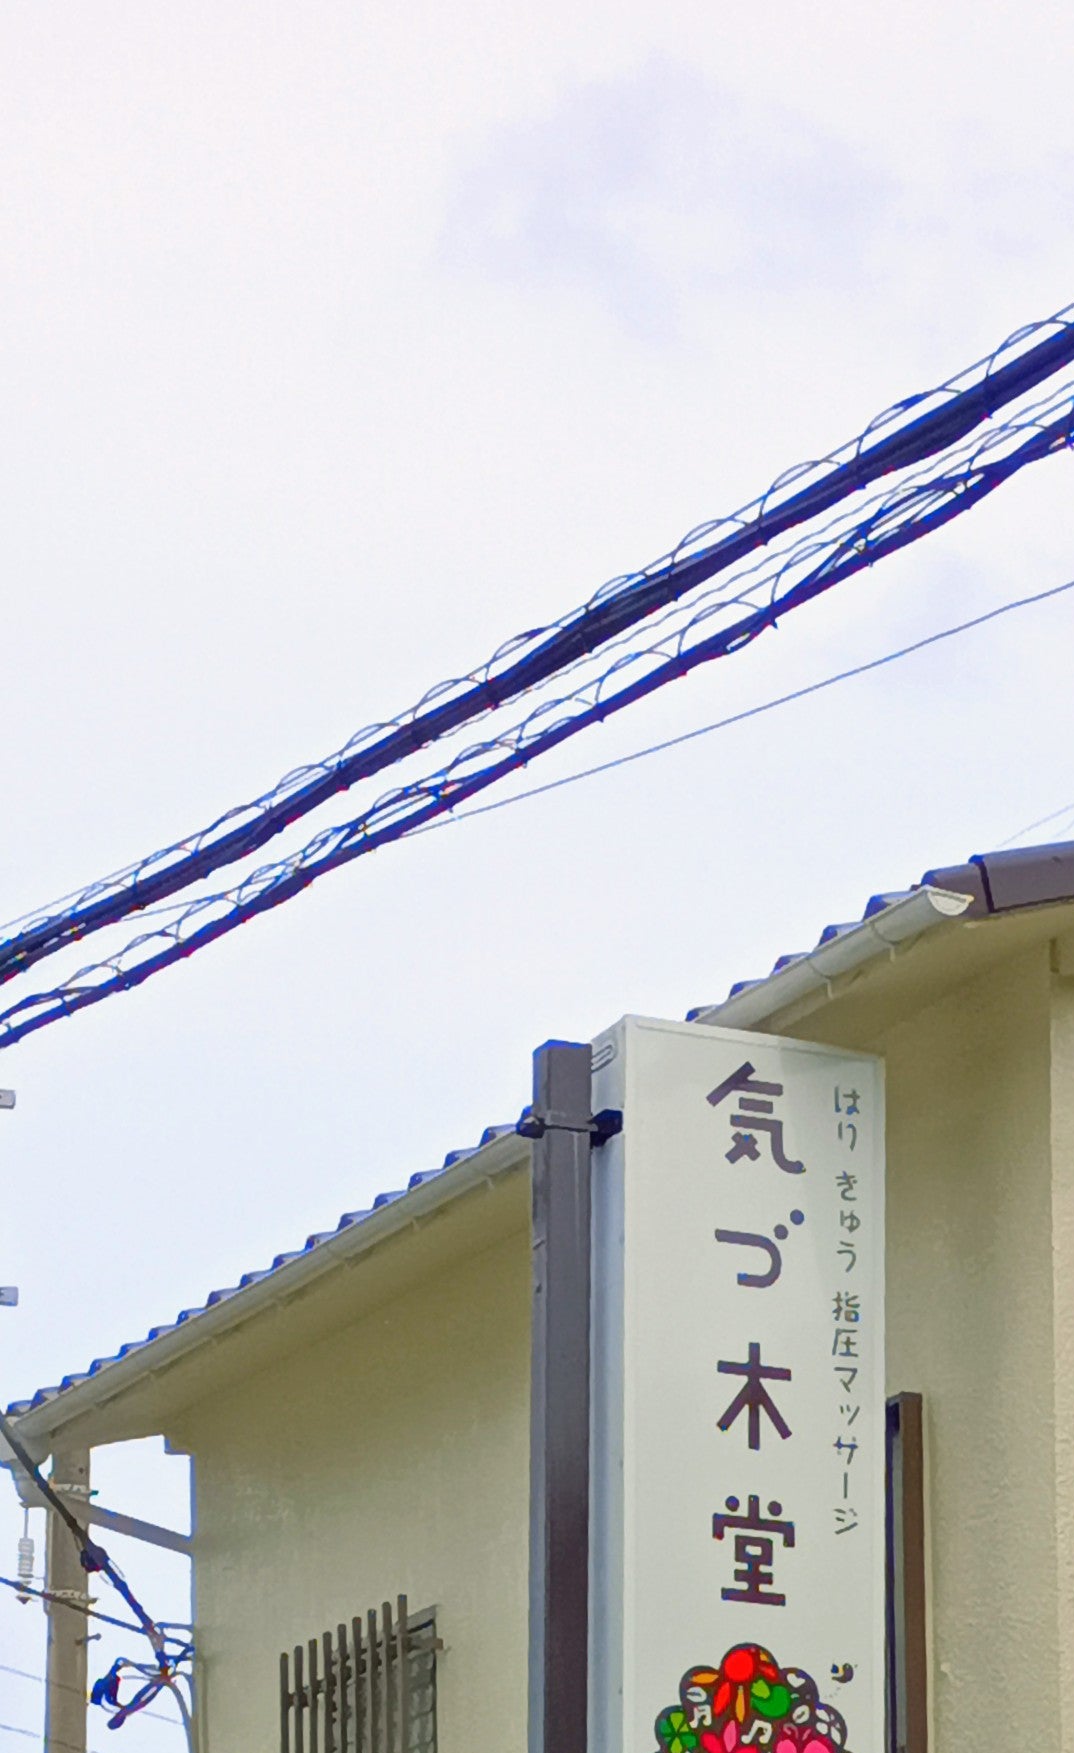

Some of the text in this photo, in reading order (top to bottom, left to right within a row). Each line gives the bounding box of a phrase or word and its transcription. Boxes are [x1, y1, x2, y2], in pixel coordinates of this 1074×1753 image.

[834, 1086, 861, 1151] はり
[835, 1171, 861, 1273] きゅう
[706, 1061, 806, 1606] 気づ木堂
